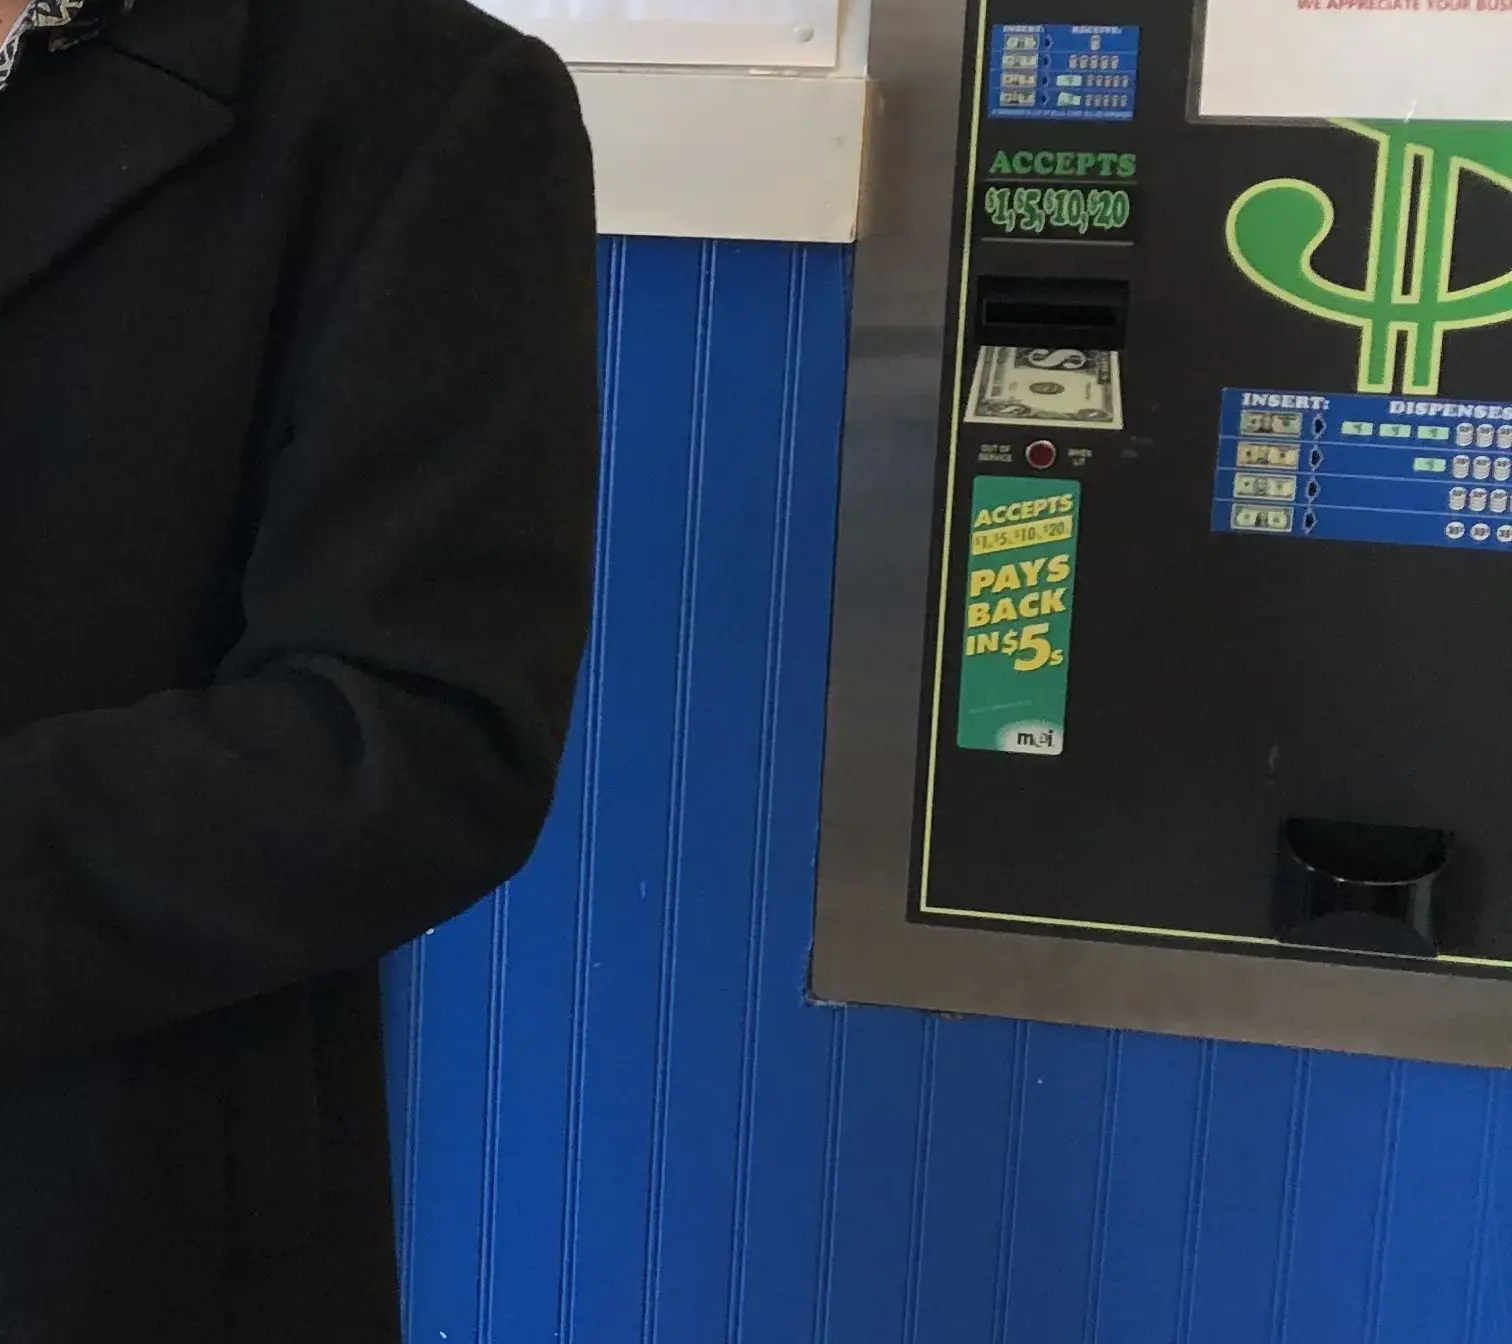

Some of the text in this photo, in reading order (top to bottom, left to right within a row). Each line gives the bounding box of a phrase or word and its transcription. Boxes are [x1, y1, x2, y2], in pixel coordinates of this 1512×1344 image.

[989, 150, 1136, 177] ACCEPTS
[973, 494, 1073, 528] ACCEPTS
[969, 554, 1070, 598] PAYS
[967, 588, 1067, 629] BACK
[965, 632, 998, 656] IN
